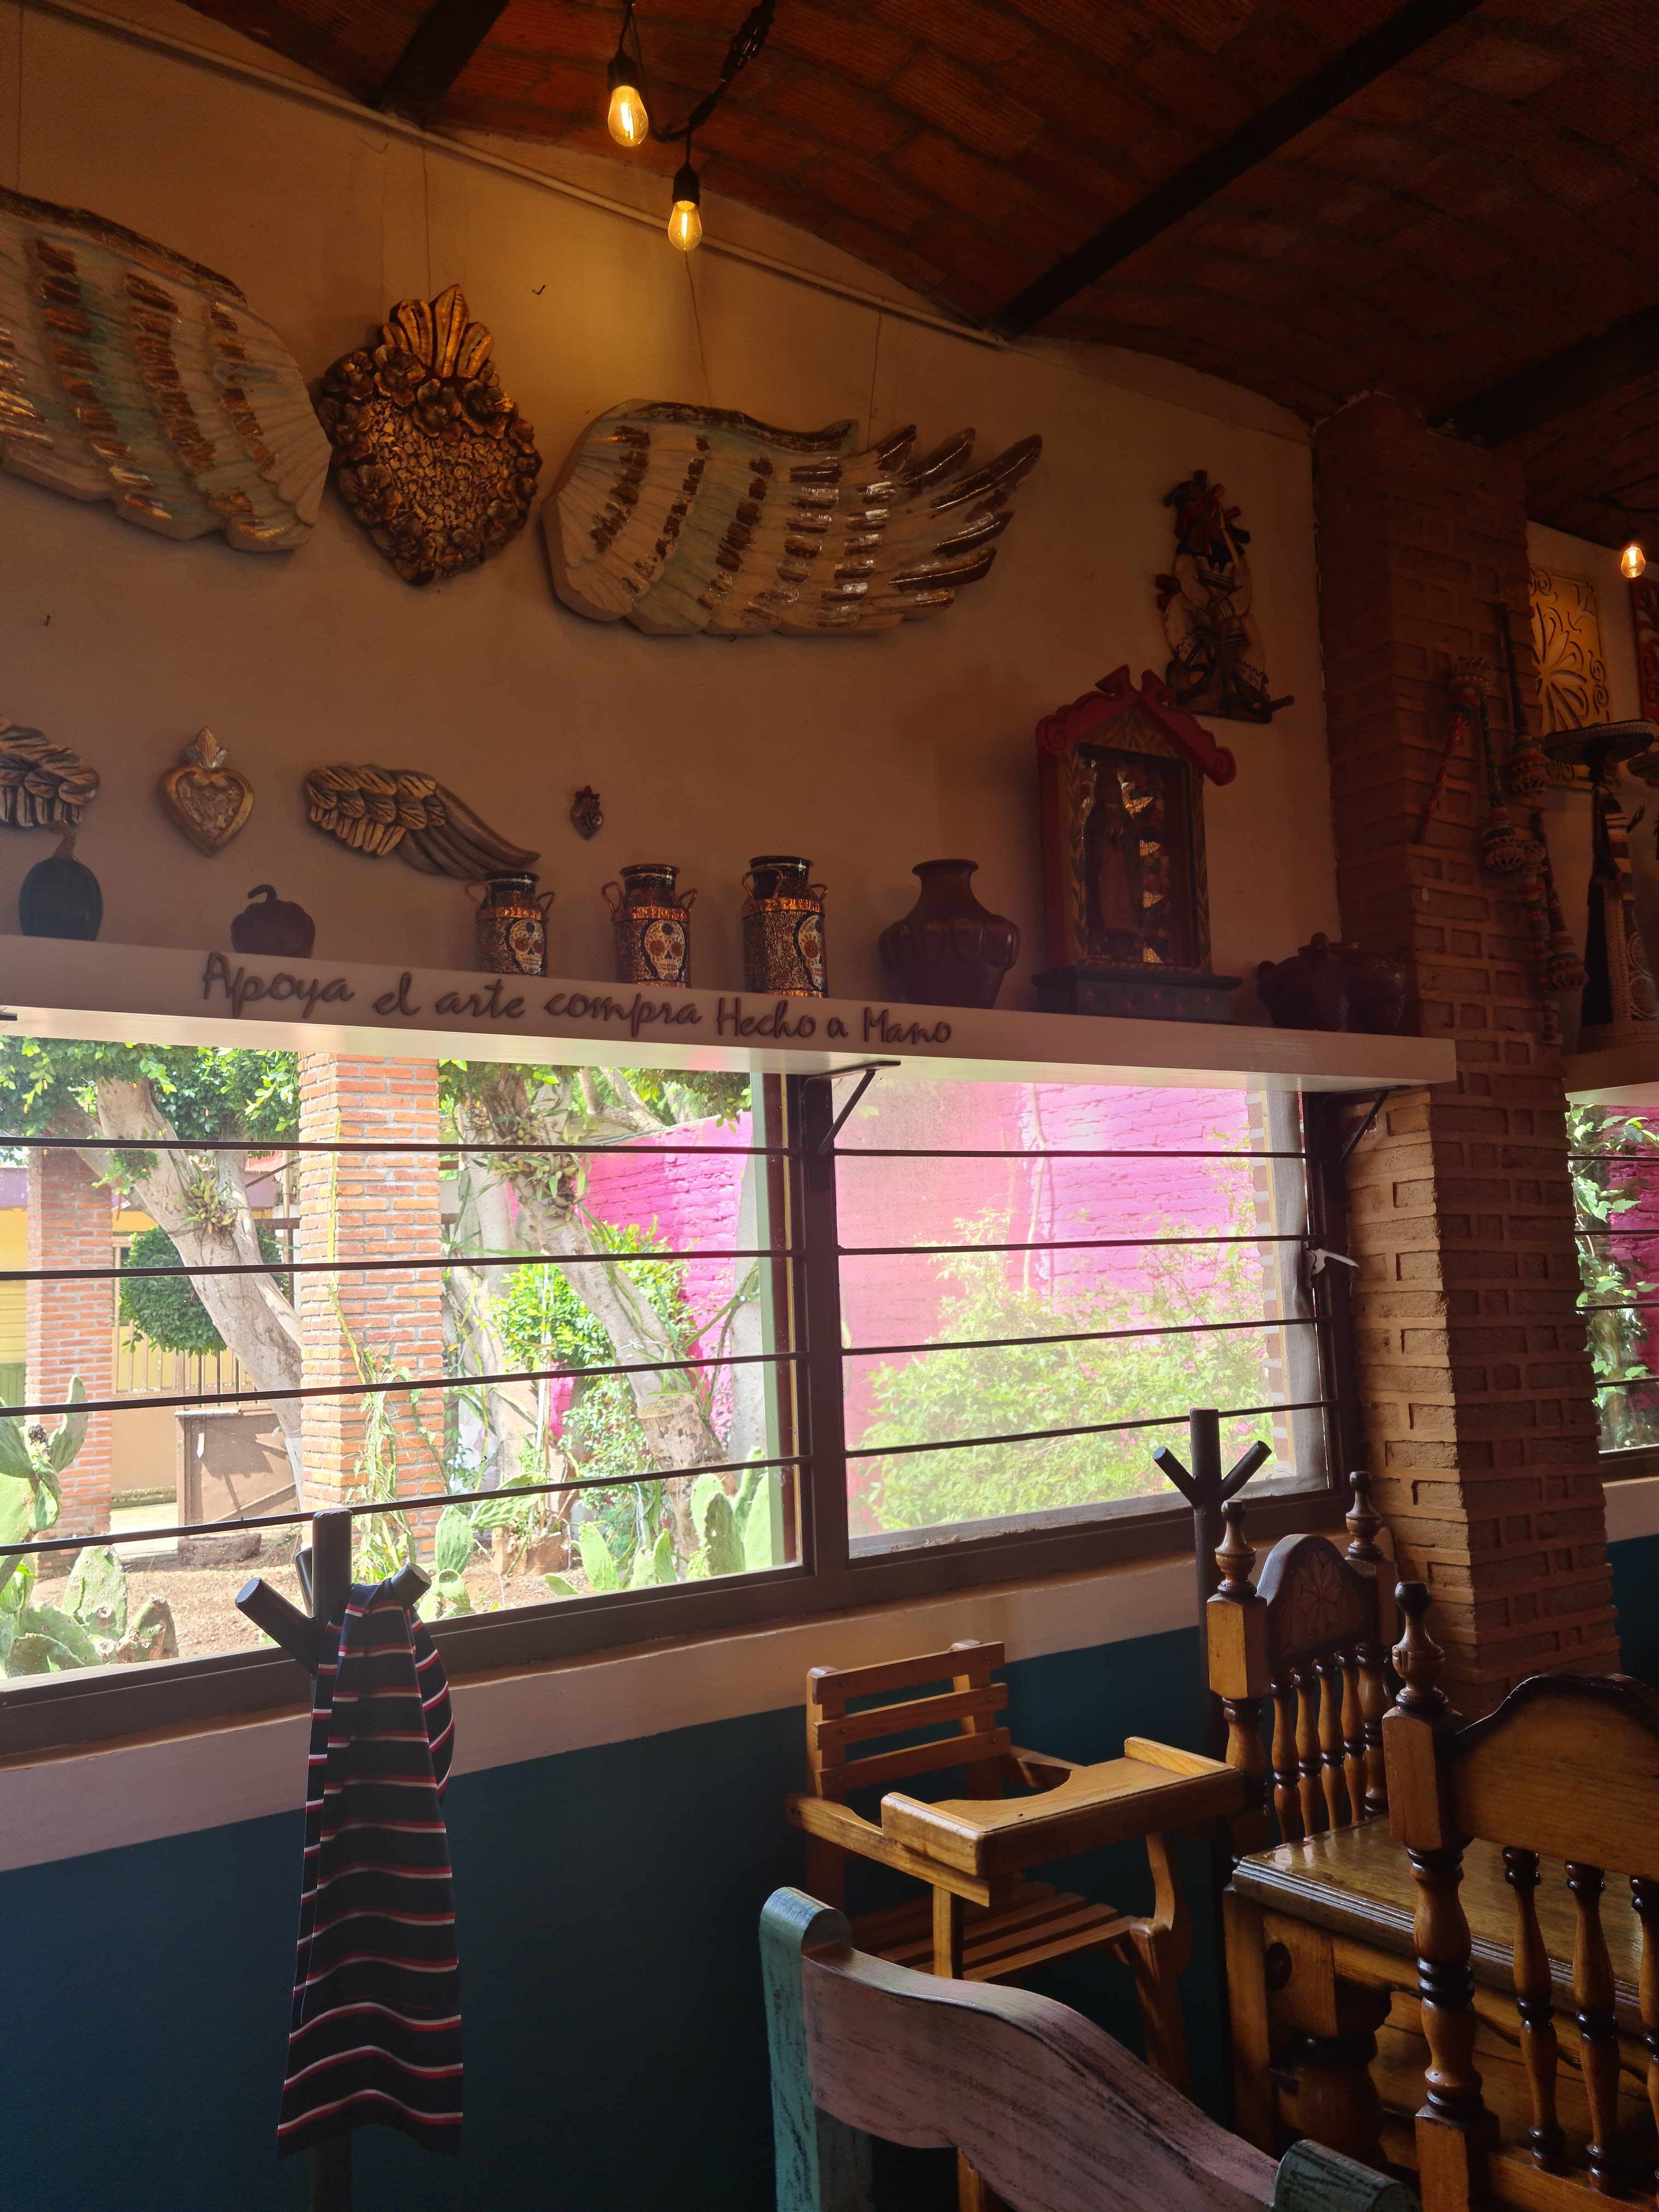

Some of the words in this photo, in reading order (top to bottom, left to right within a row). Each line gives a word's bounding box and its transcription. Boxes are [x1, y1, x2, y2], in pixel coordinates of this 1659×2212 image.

[203, 951, 355, 1019] Apoya
[372, 971, 421, 1015] el
[435, 979, 525, 1019] arte
[543, 992, 703, 1038] compra
[716, 997, 817, 1039] Hecho
[827, 1017, 849, 1038] a
[863, 1006, 952, 1045] Mano
